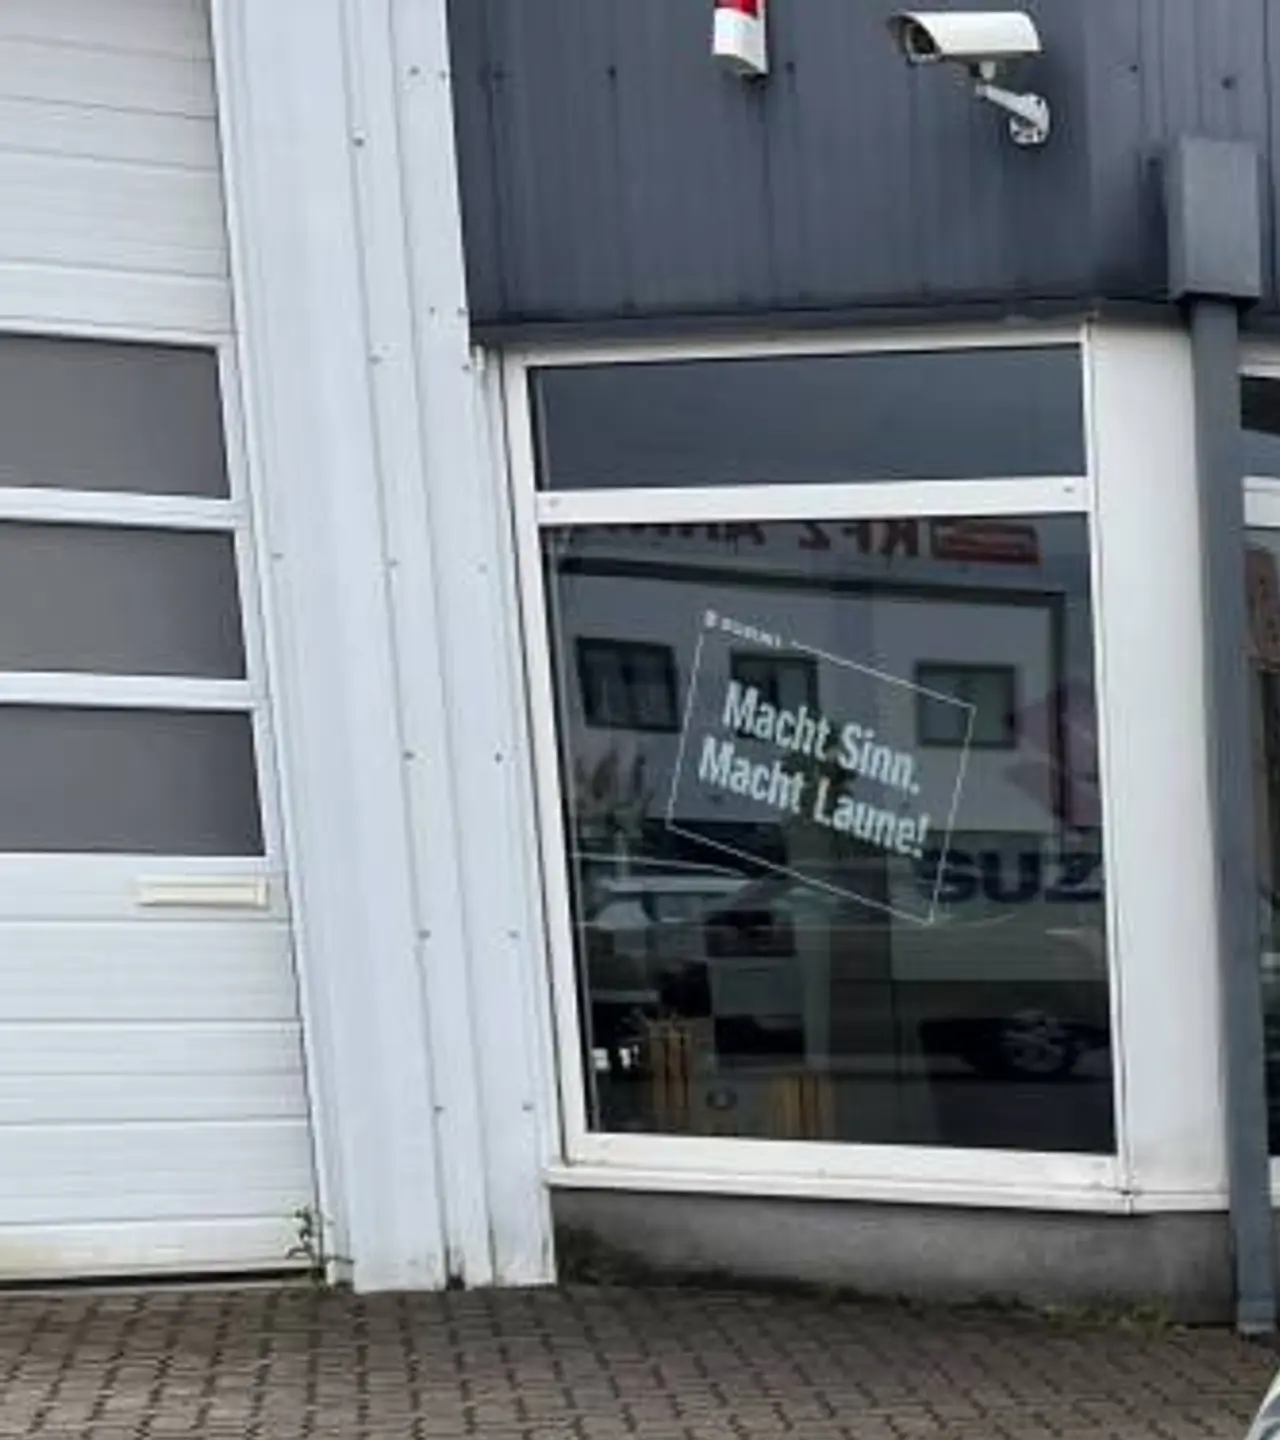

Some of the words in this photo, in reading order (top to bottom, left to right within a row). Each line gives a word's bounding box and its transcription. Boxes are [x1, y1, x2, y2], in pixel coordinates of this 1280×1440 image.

[699, 735, 804, 814] Macht
[813, 776, 930, 858] Laune!
[722, 680, 831, 761] Macht
[837, 723, 921, 795] Sinn.
